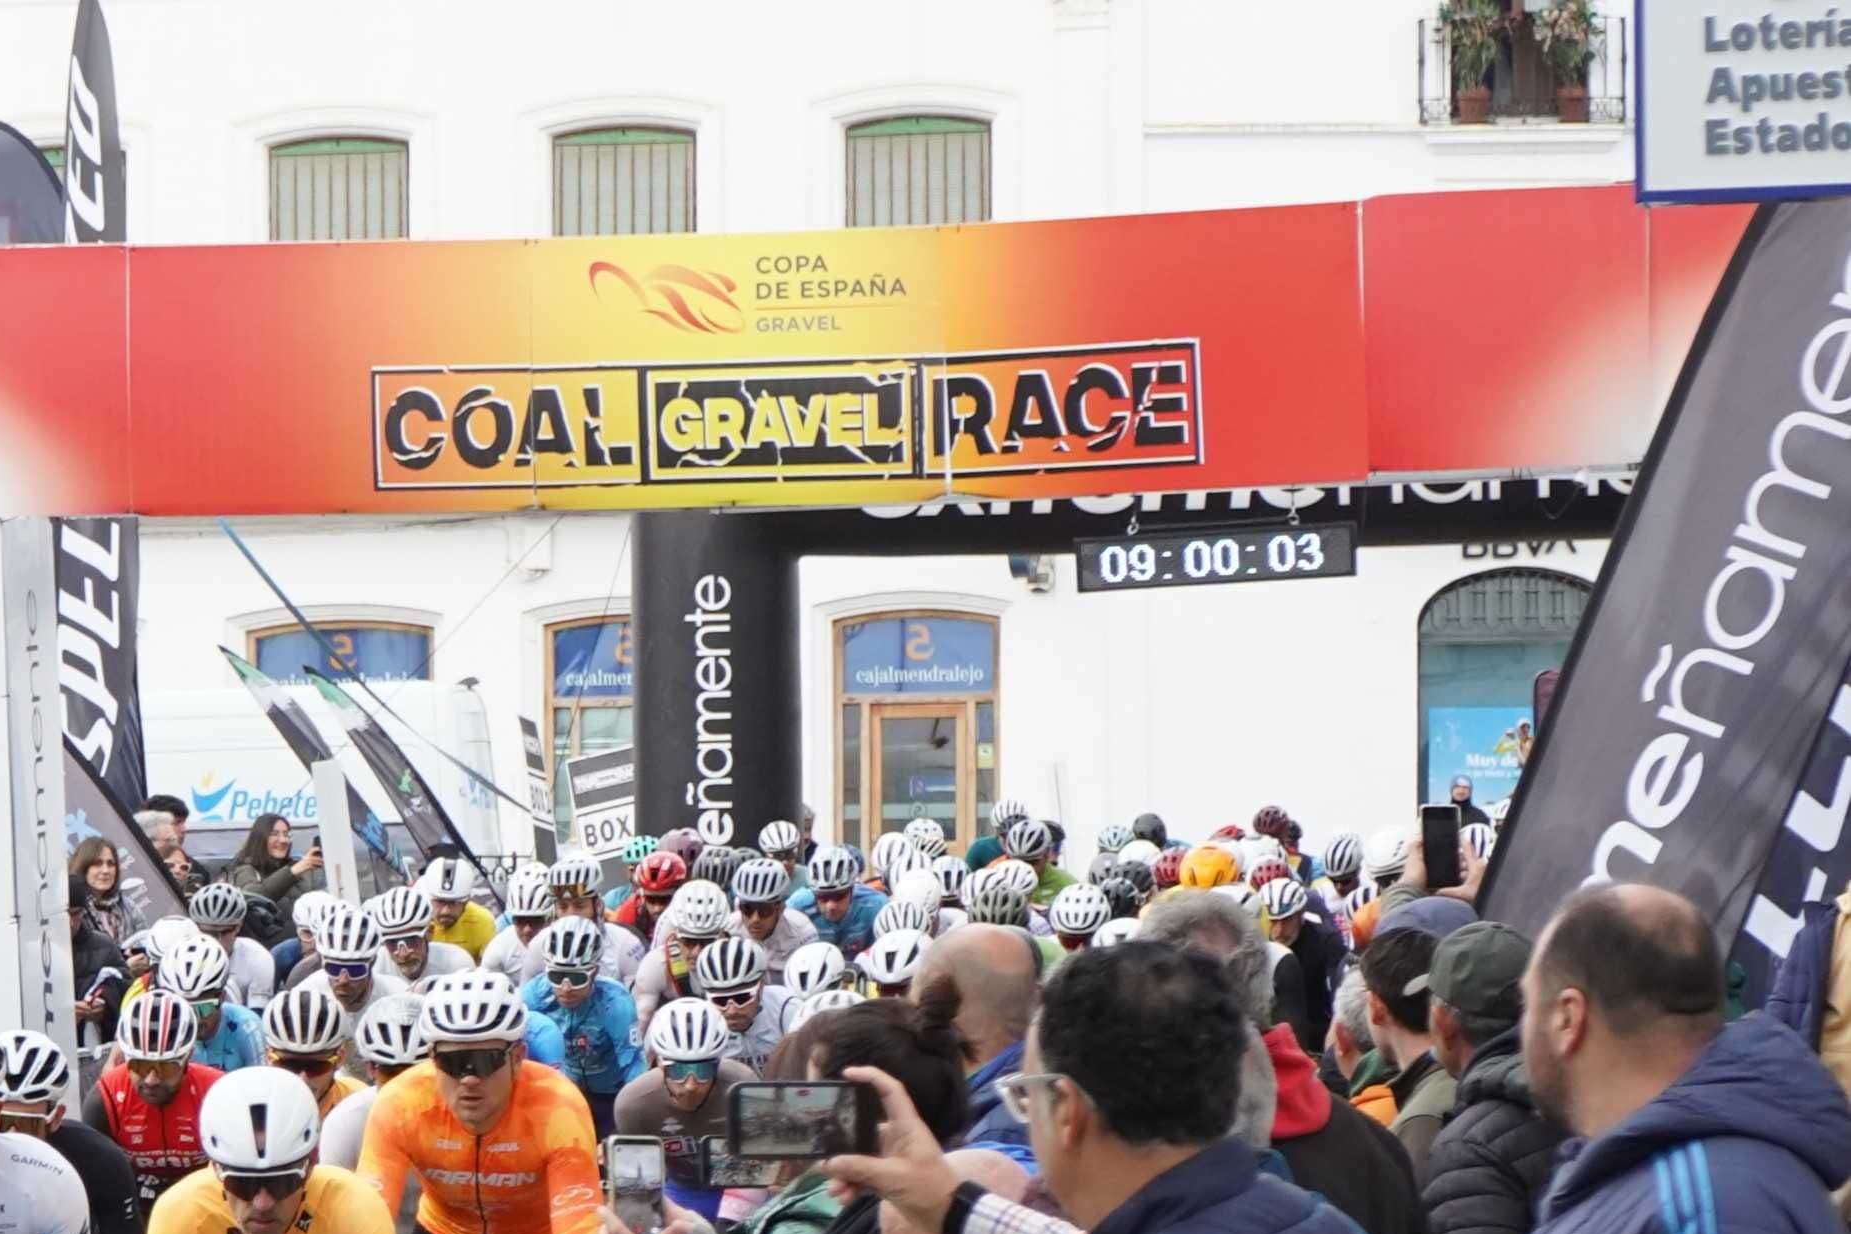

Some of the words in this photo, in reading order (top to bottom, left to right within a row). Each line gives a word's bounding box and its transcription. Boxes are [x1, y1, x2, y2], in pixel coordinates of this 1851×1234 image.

[756, 255, 829, 276] COPA
[756, 280, 790, 301] DE
[799, 272, 907, 298] ESPAÑA
[756, 315, 843, 334] GRAVEL
[384, 385, 636, 470] COAL
[659, 390, 906, 456] GRAVEL
[930, 358, 1191, 458] RACE
[855, 664, 985, 687] cajalmendralejo
[685, 574, 734, 850] eñamente
[583, 814, 632, 848] BOX
[9, 1153, 64, 1176] GARMIN
